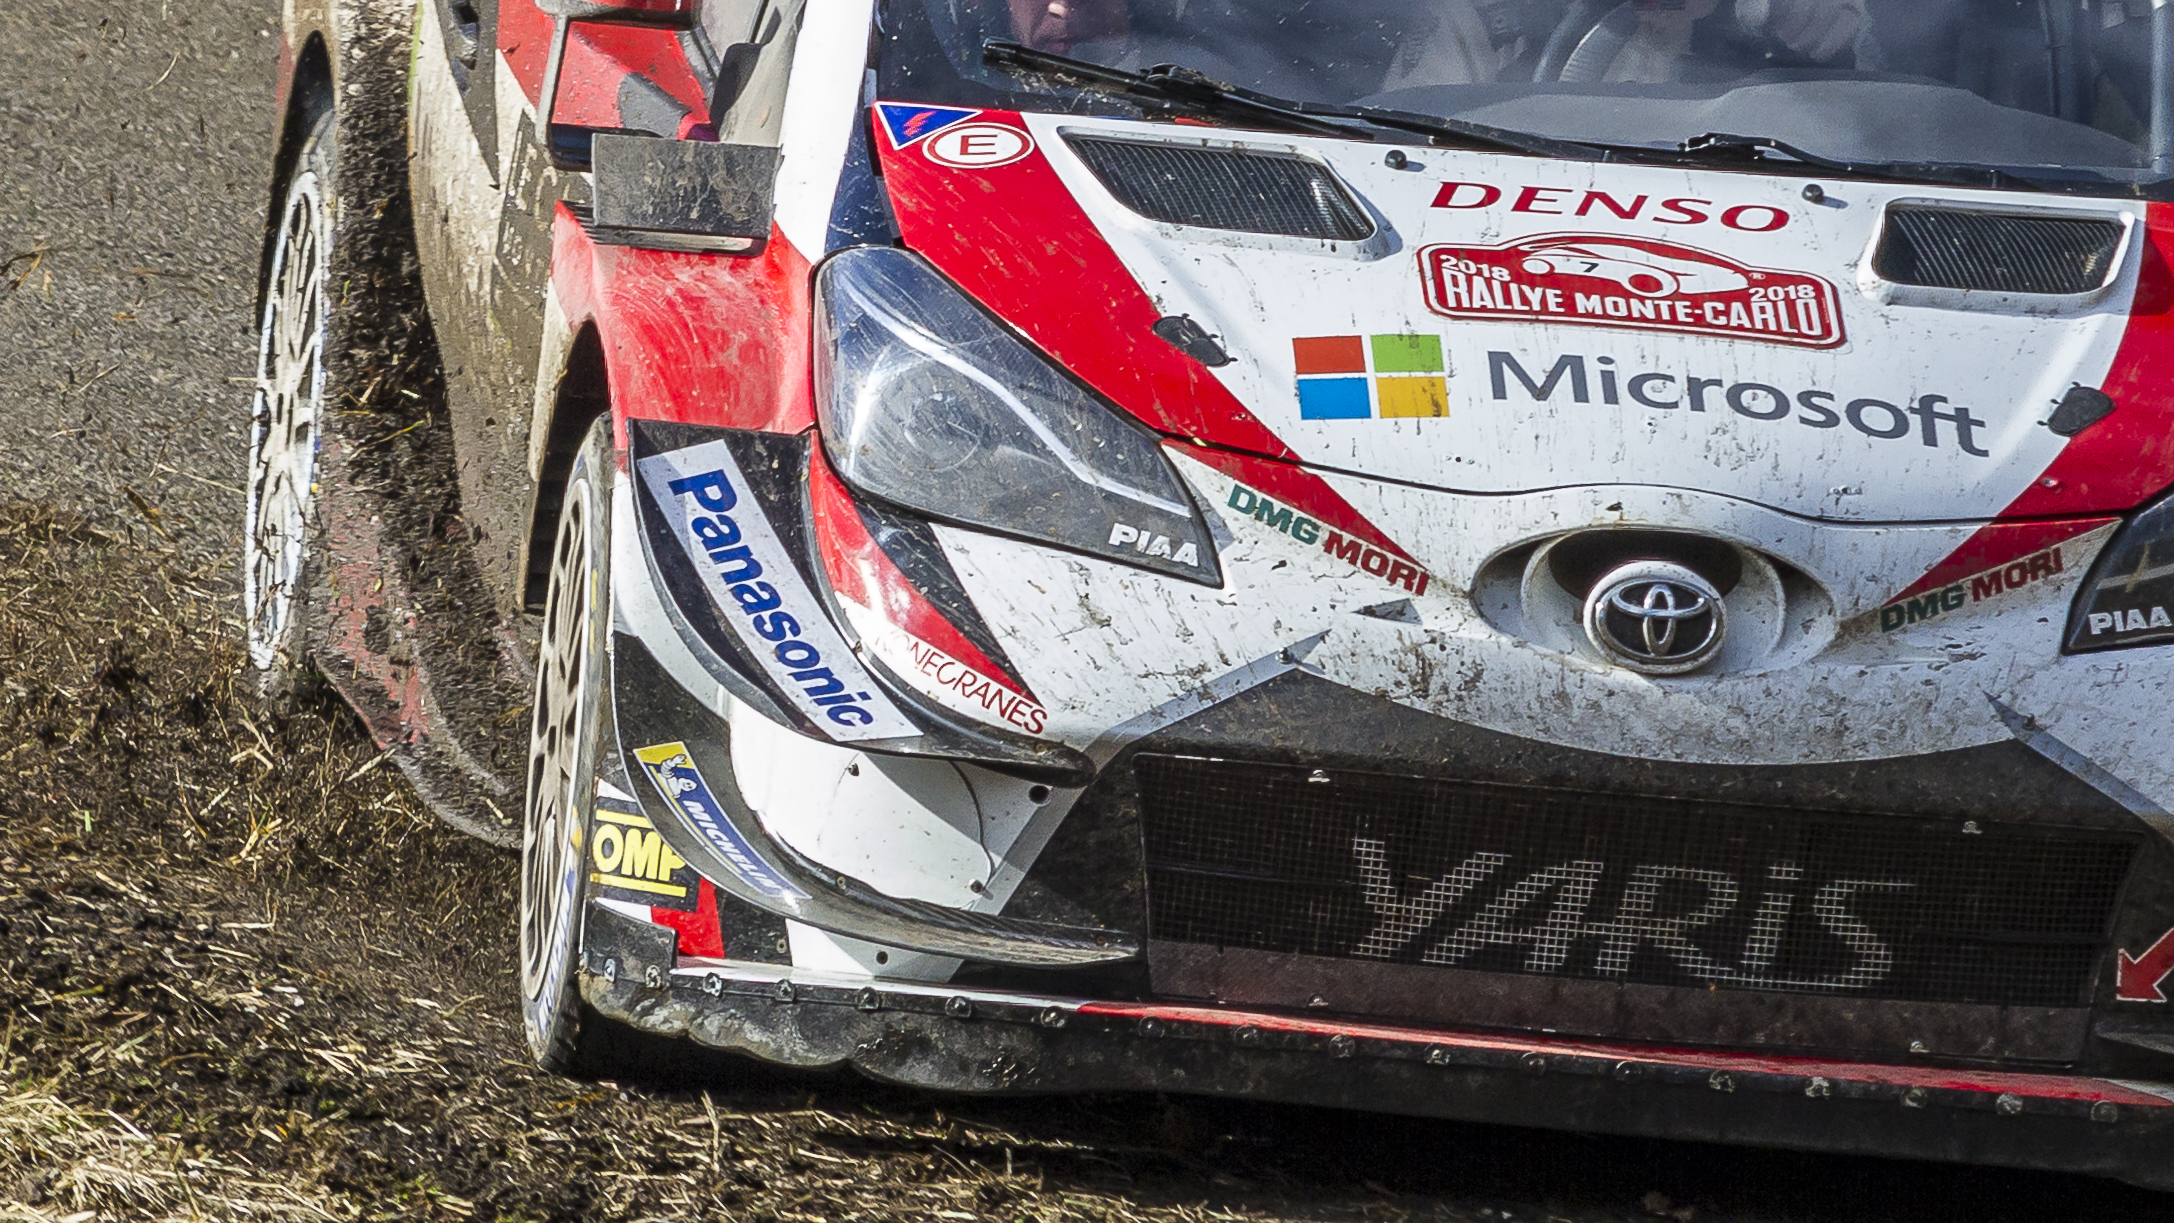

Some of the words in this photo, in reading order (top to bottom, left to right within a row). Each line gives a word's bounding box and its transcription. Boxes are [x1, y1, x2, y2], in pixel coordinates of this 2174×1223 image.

[959, 134, 998, 156] E
[1429, 181, 1791, 232] DENSO
[1438, 254, 1512, 282] 2018
[1579, 260, 1600, 273] 7
[1748, 284, 1816, 302] 2018
[1441, 267, 1566, 313] RALLYE
[1574, 292, 1823, 336] MONTE-CARLO
[1487, 350, 1990, 458] Microsoft
[1107, 522, 1199, 567] PIAA
[1227, 483, 1321, 545] DMG
[1323, 530, 1431, 597] MORI
[667, 469, 874, 727] Panasonic
[1879, 584, 1967, 634] DMG
[1971, 547, 2065, 602] MORI
[2088, 606, 2173, 635] PIAA
[592, 823, 687, 882] OMP
[682, 799, 782, 891] MICHELIN
